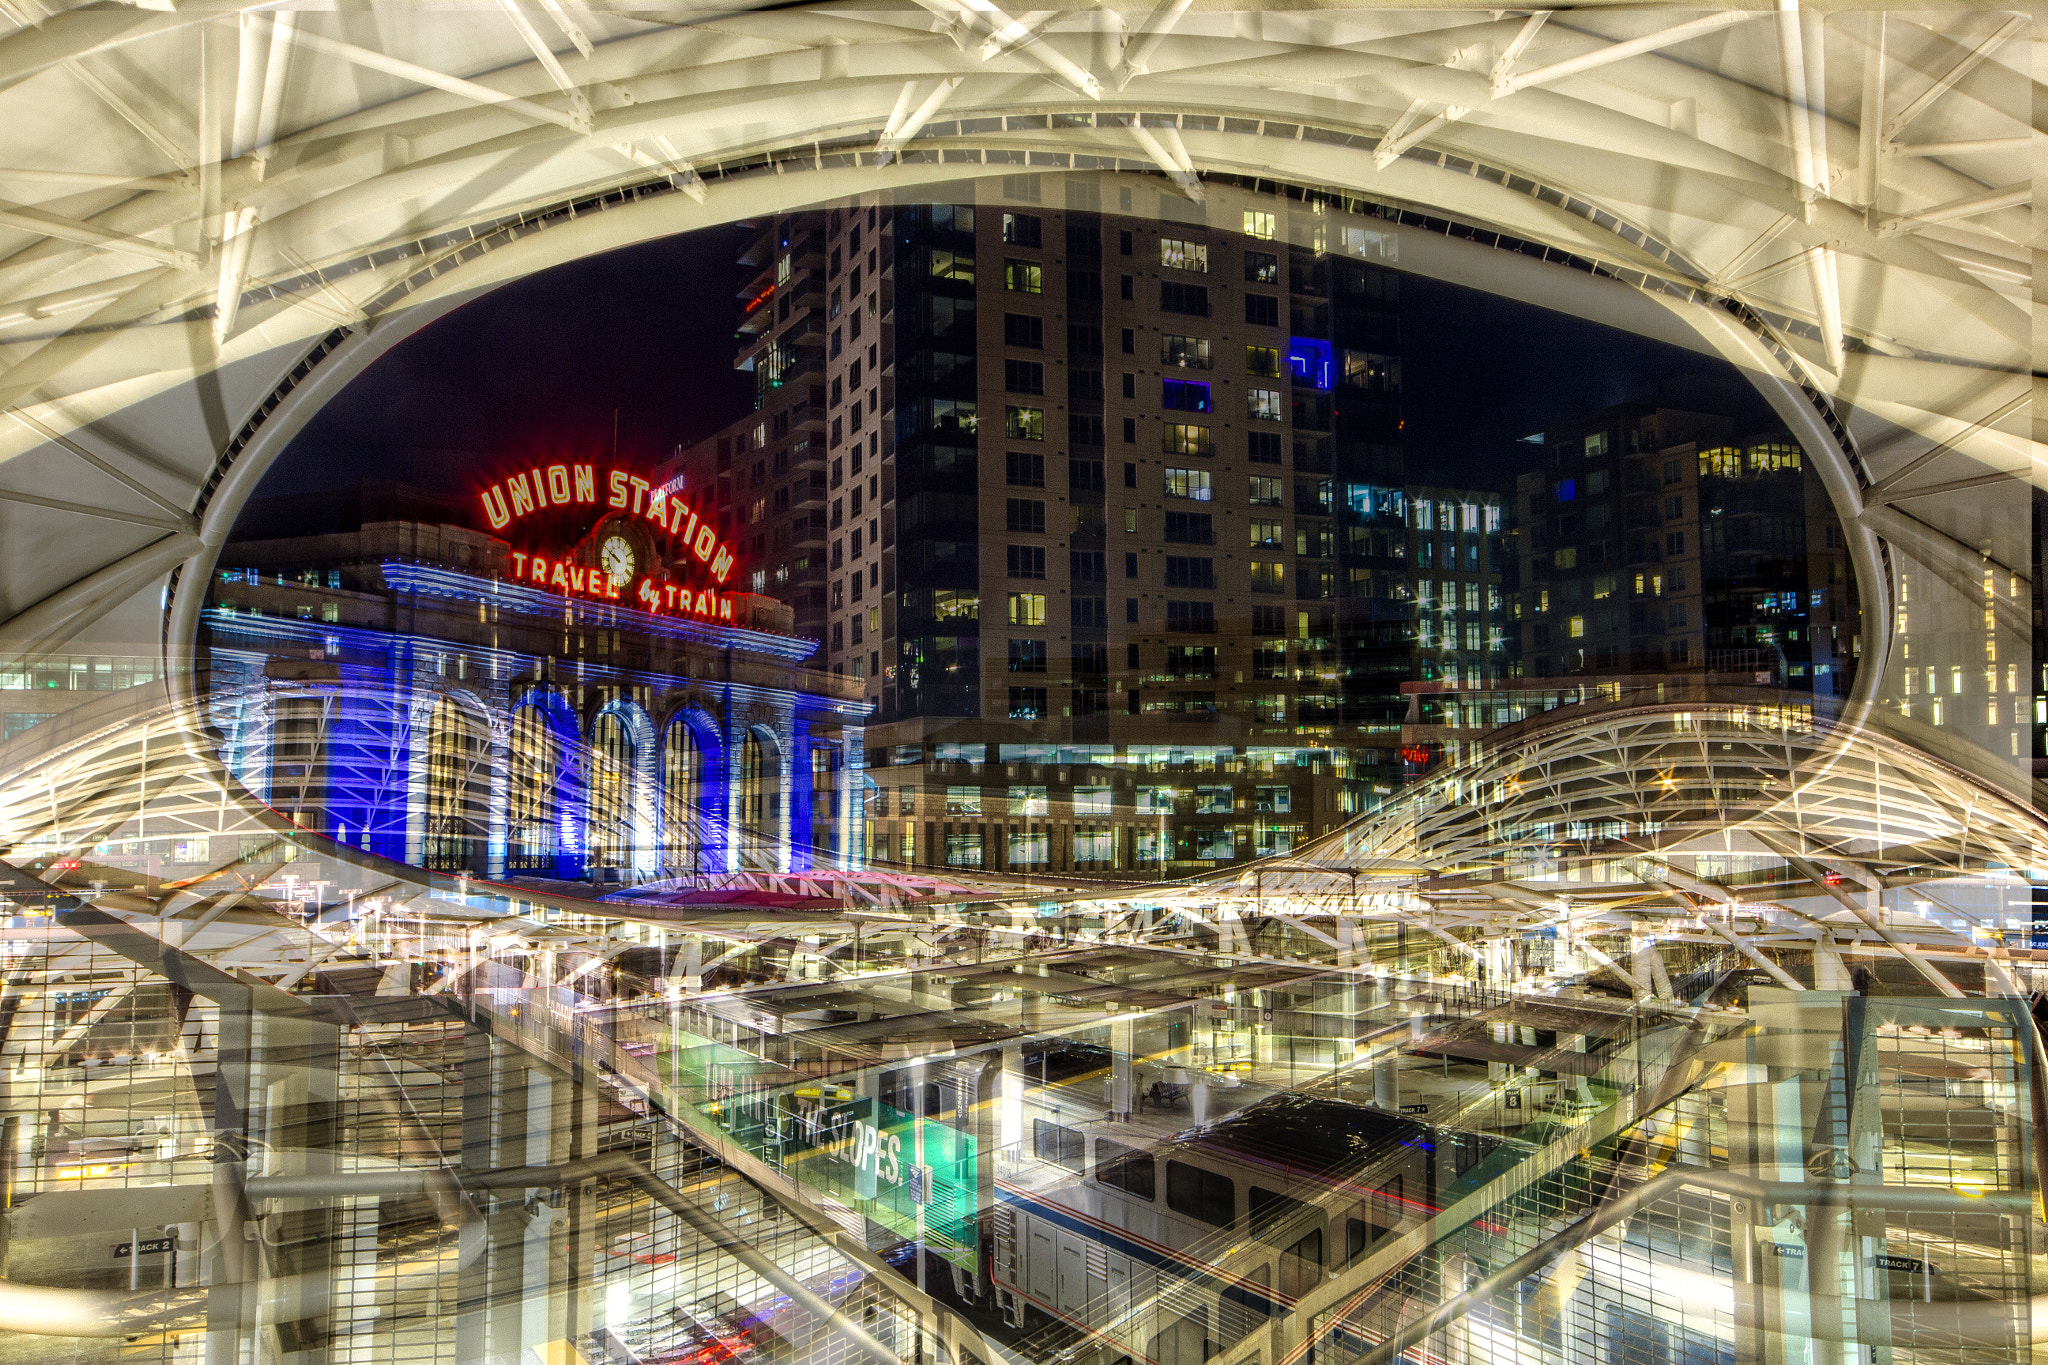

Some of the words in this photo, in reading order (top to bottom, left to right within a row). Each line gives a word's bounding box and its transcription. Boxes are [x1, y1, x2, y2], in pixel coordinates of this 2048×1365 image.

[481, 464, 595, 530] UNION
[609, 470, 734, 583] STATION
[512, 552, 619, 598] TRAVEL
[639, 579, 660, 613] by
[665, 585, 731, 619] TRAIN
[1509, 1095, 1517, 1107] 8
[797, 1097, 828, 1151] THE
[828, 1111, 904, 1188] SLOPES.
[161, 1240, 170, 1250] 2
[1879, 1257, 1909, 1269] TRACK
[1912, 1261, 1920, 1271] 7
